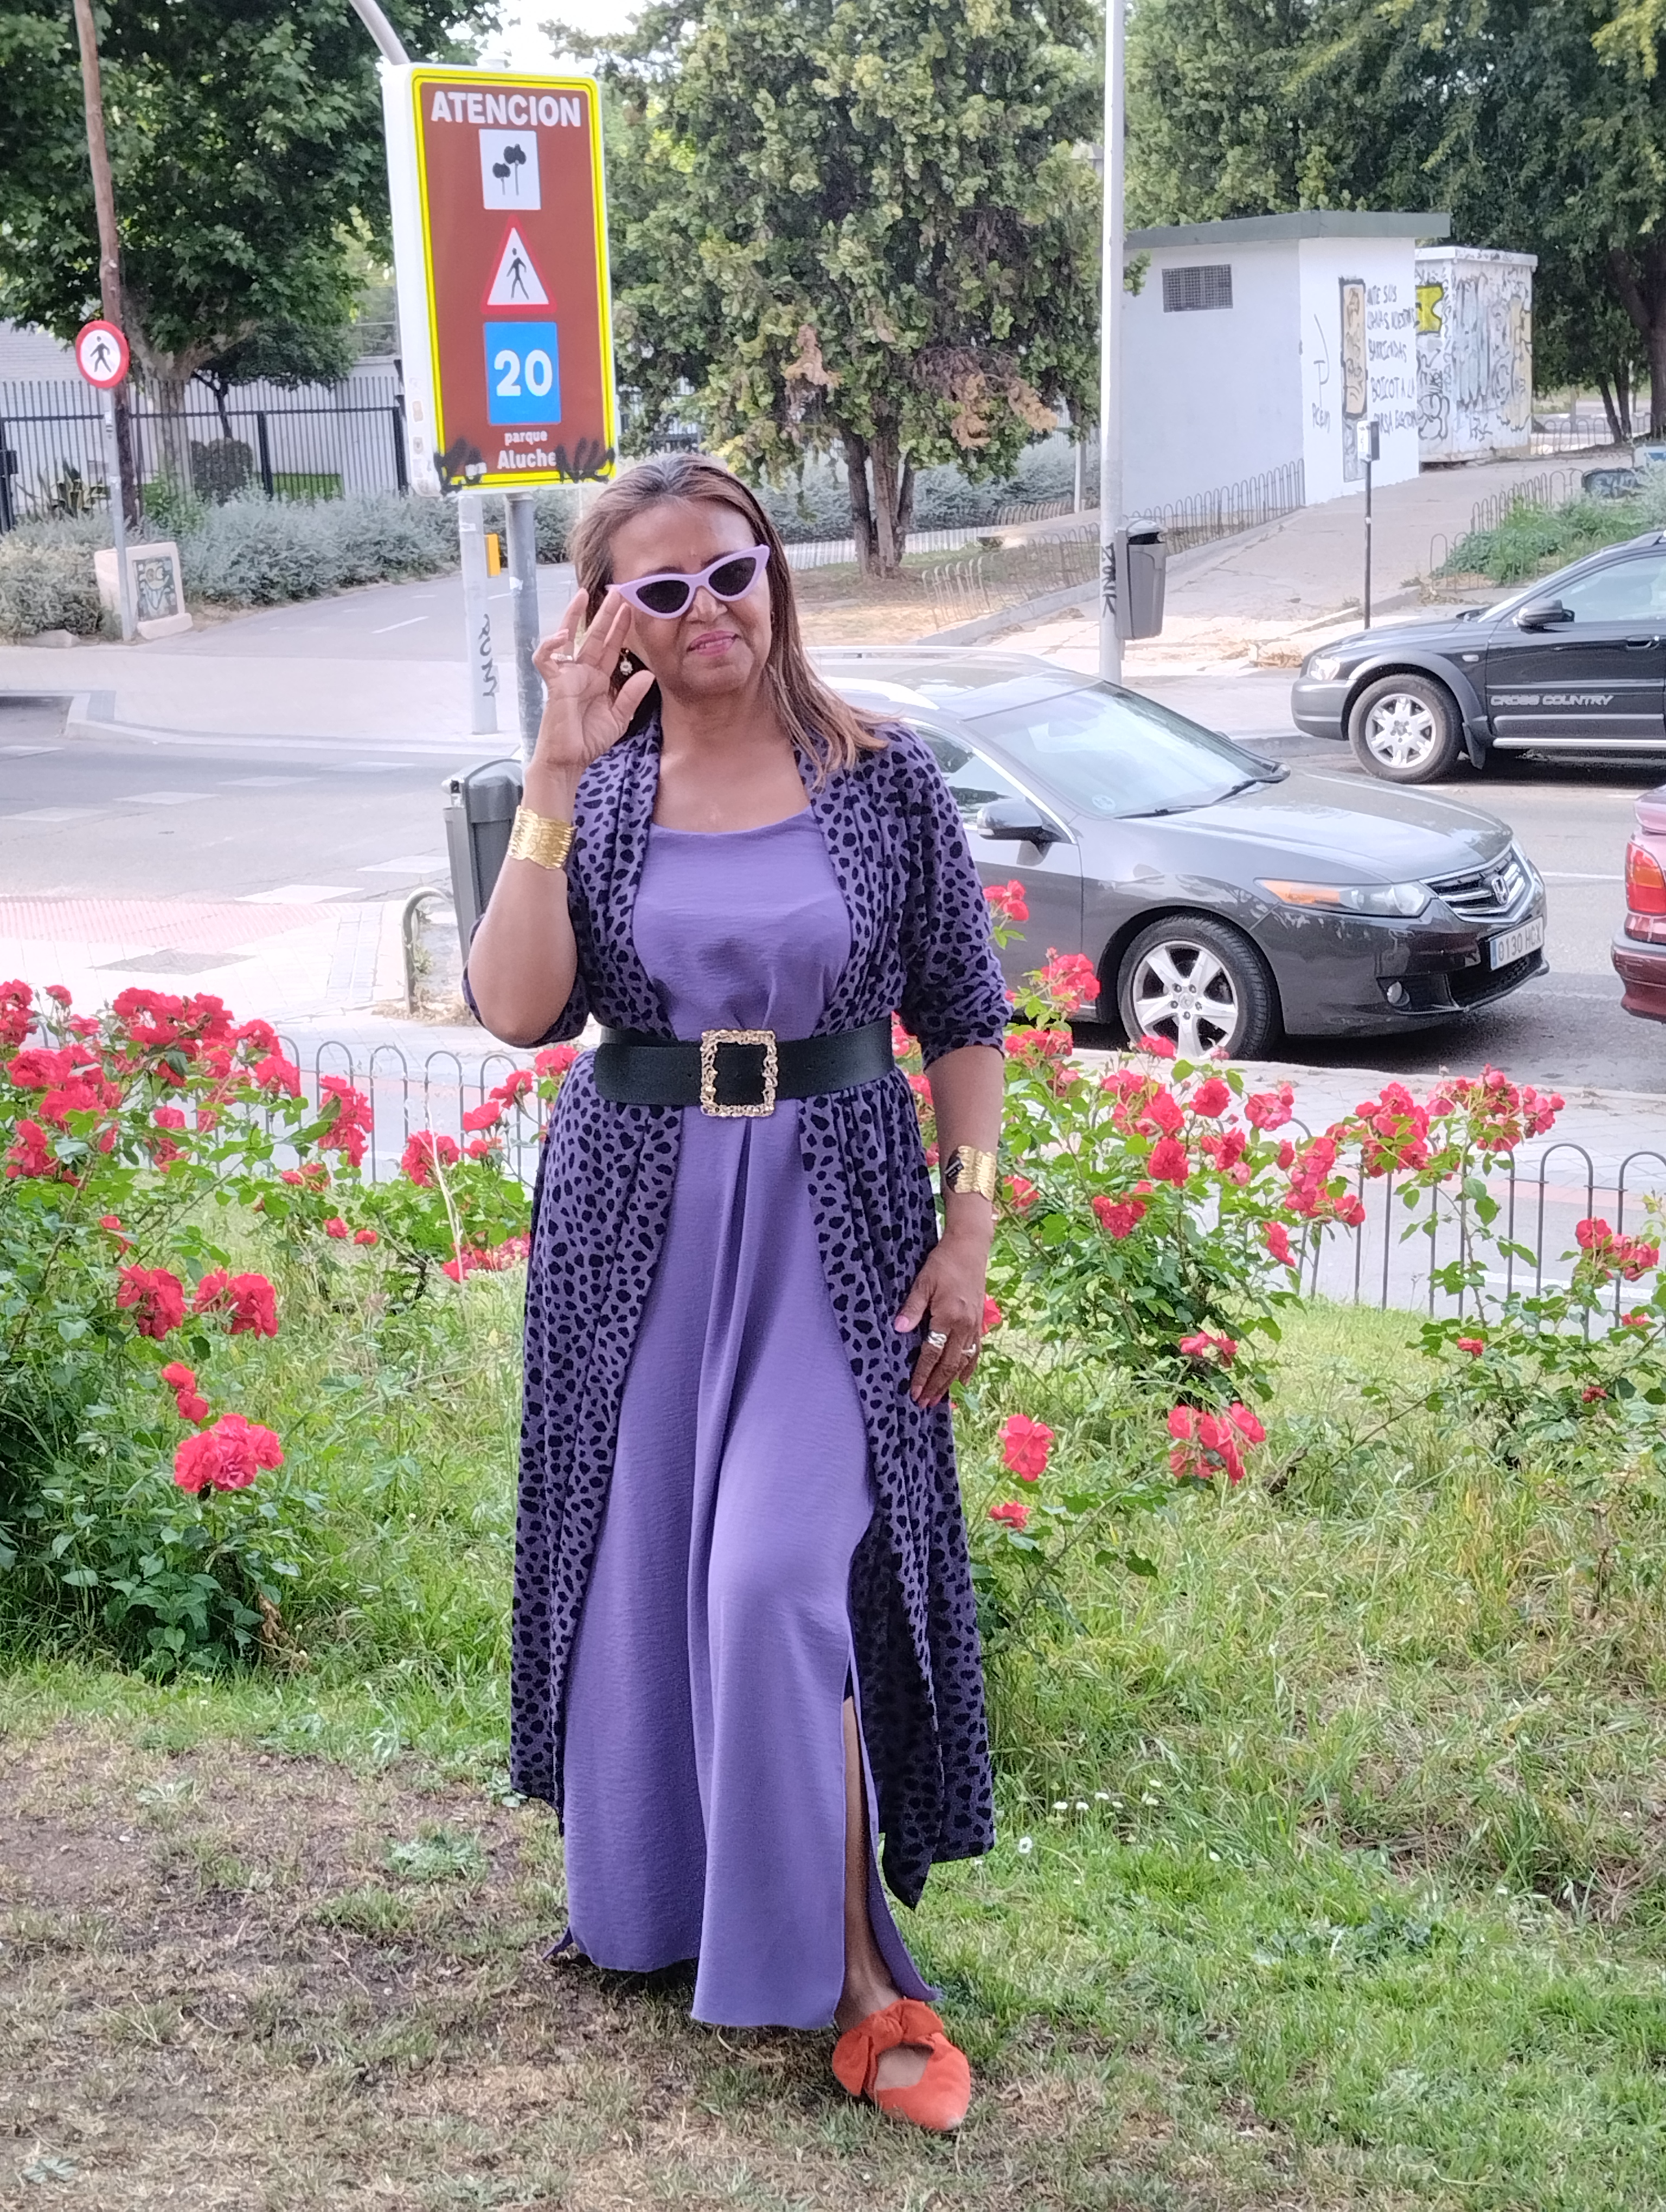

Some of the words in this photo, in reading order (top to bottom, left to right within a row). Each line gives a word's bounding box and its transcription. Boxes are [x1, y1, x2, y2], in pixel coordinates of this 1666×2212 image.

[431, 91, 581, 127] ATENCION
[494, 349, 553, 396] 20
[504, 430, 547, 446] parque
[497, 449, 557, 470] Aluche
[1491, 695, 1540, 706] CROSS
[1542, 695, 1614, 706] COUNTRY
